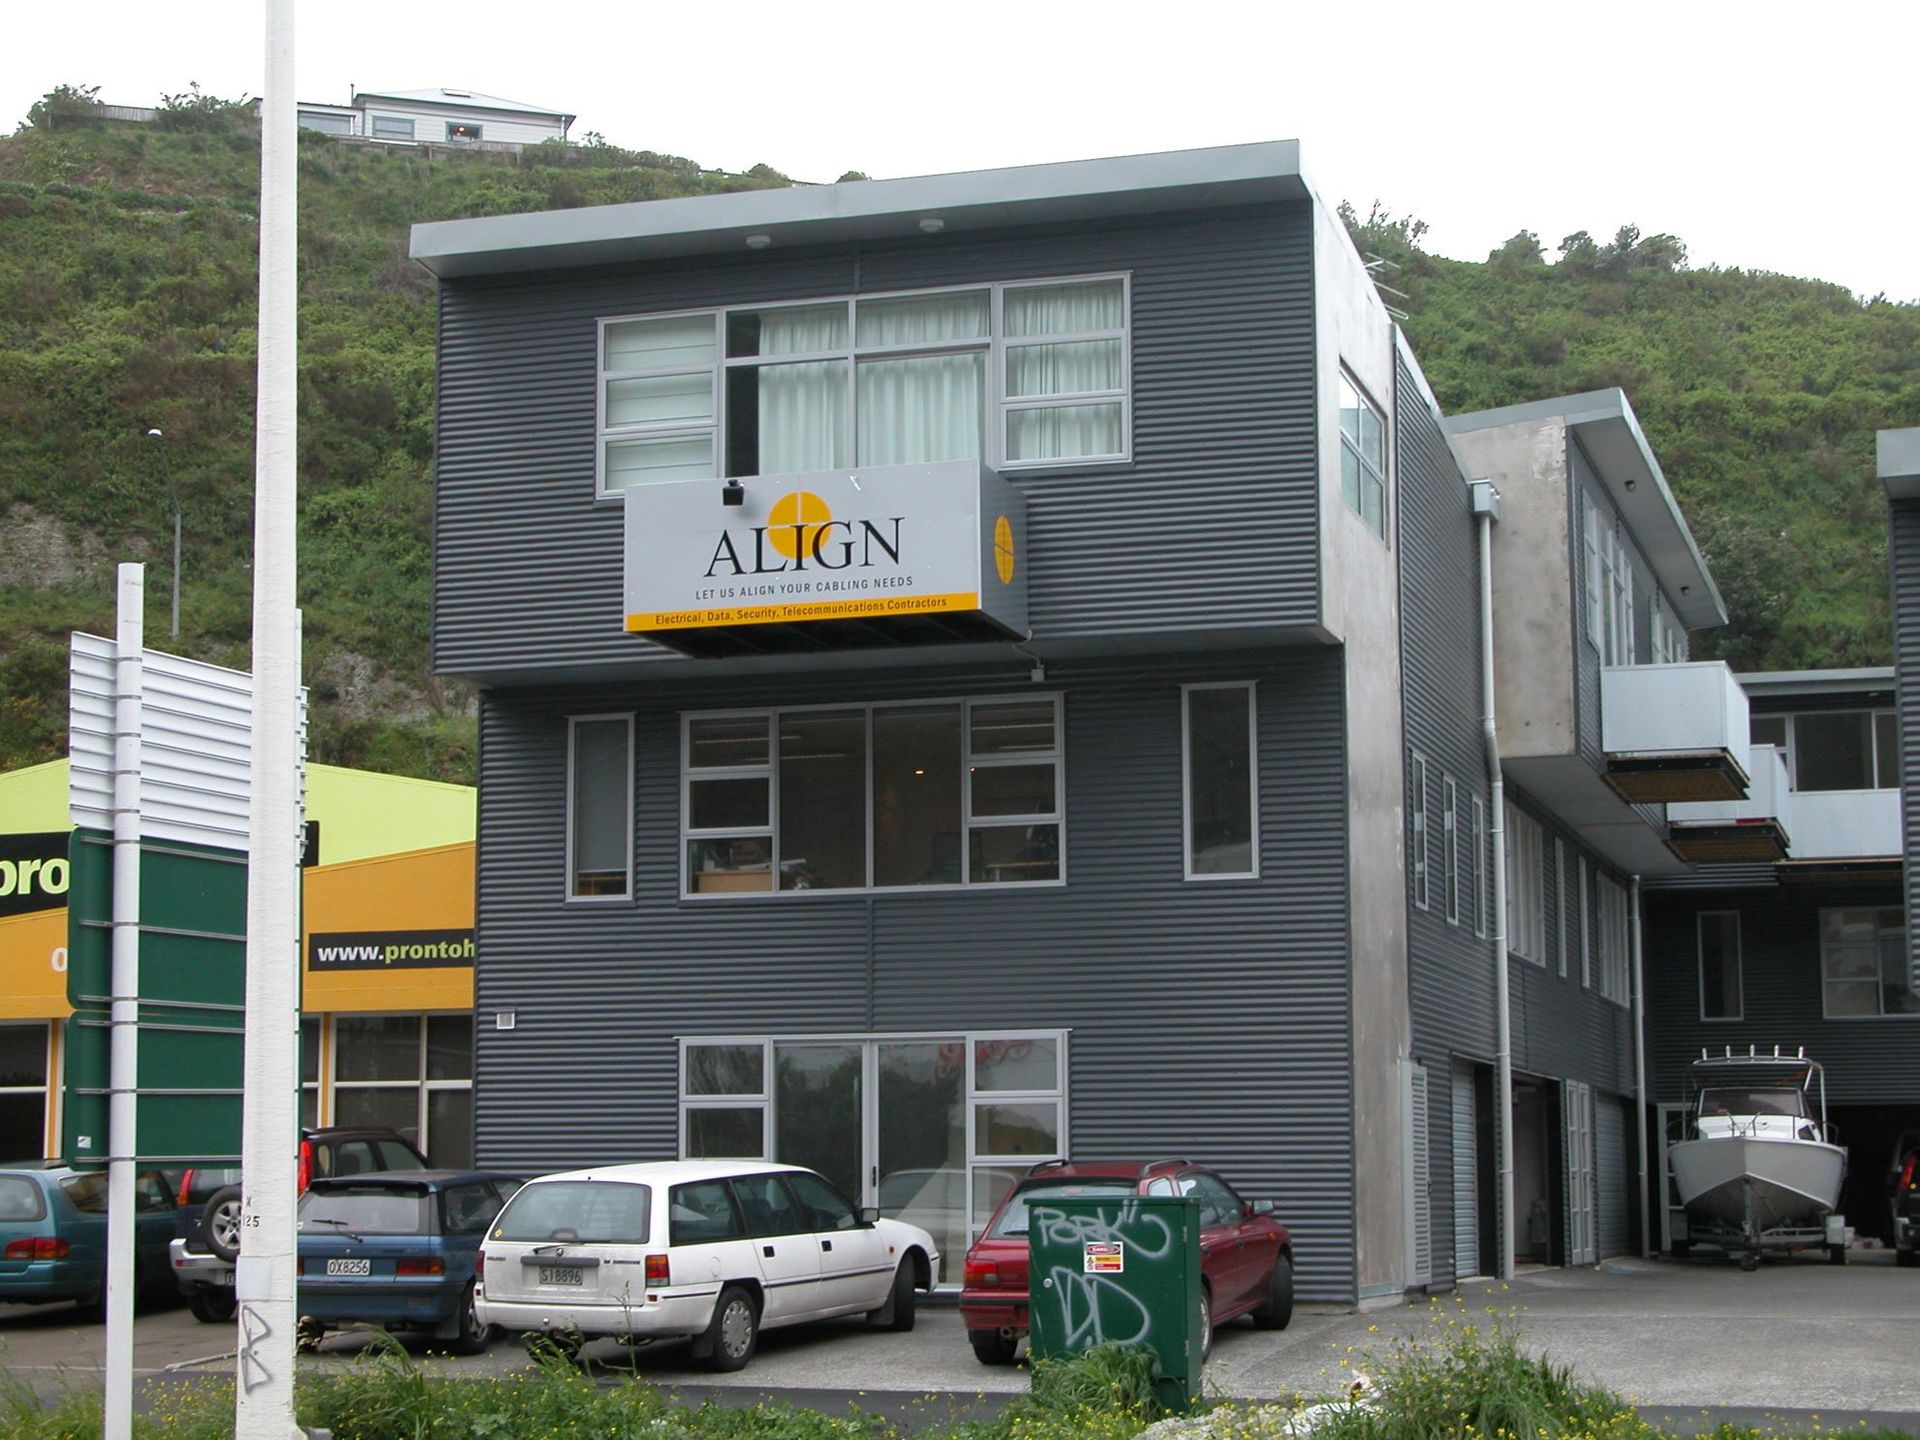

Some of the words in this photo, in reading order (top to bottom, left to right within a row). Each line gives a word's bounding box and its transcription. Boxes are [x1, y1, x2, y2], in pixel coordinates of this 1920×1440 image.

[704, 517, 905, 577] ALIGN
[696, 589, 715, 600] LET
[720, 588, 735, 598] US
[740, 585, 775, 597] ALIGN
[780, 583, 811, 594] YOUR
[816, 579, 868, 592] CABLING
[874, 576, 914, 588] NEEDS
[656, 613, 704, 625] Electrical,
[707, 611, 734, 622] Data,
[737, 607, 779, 620] Security,
[783, 601, 884, 616] Telecommunications
[887, 597, 947, 610] Contractors
[328, 1261, 369, 1274] OX8256
